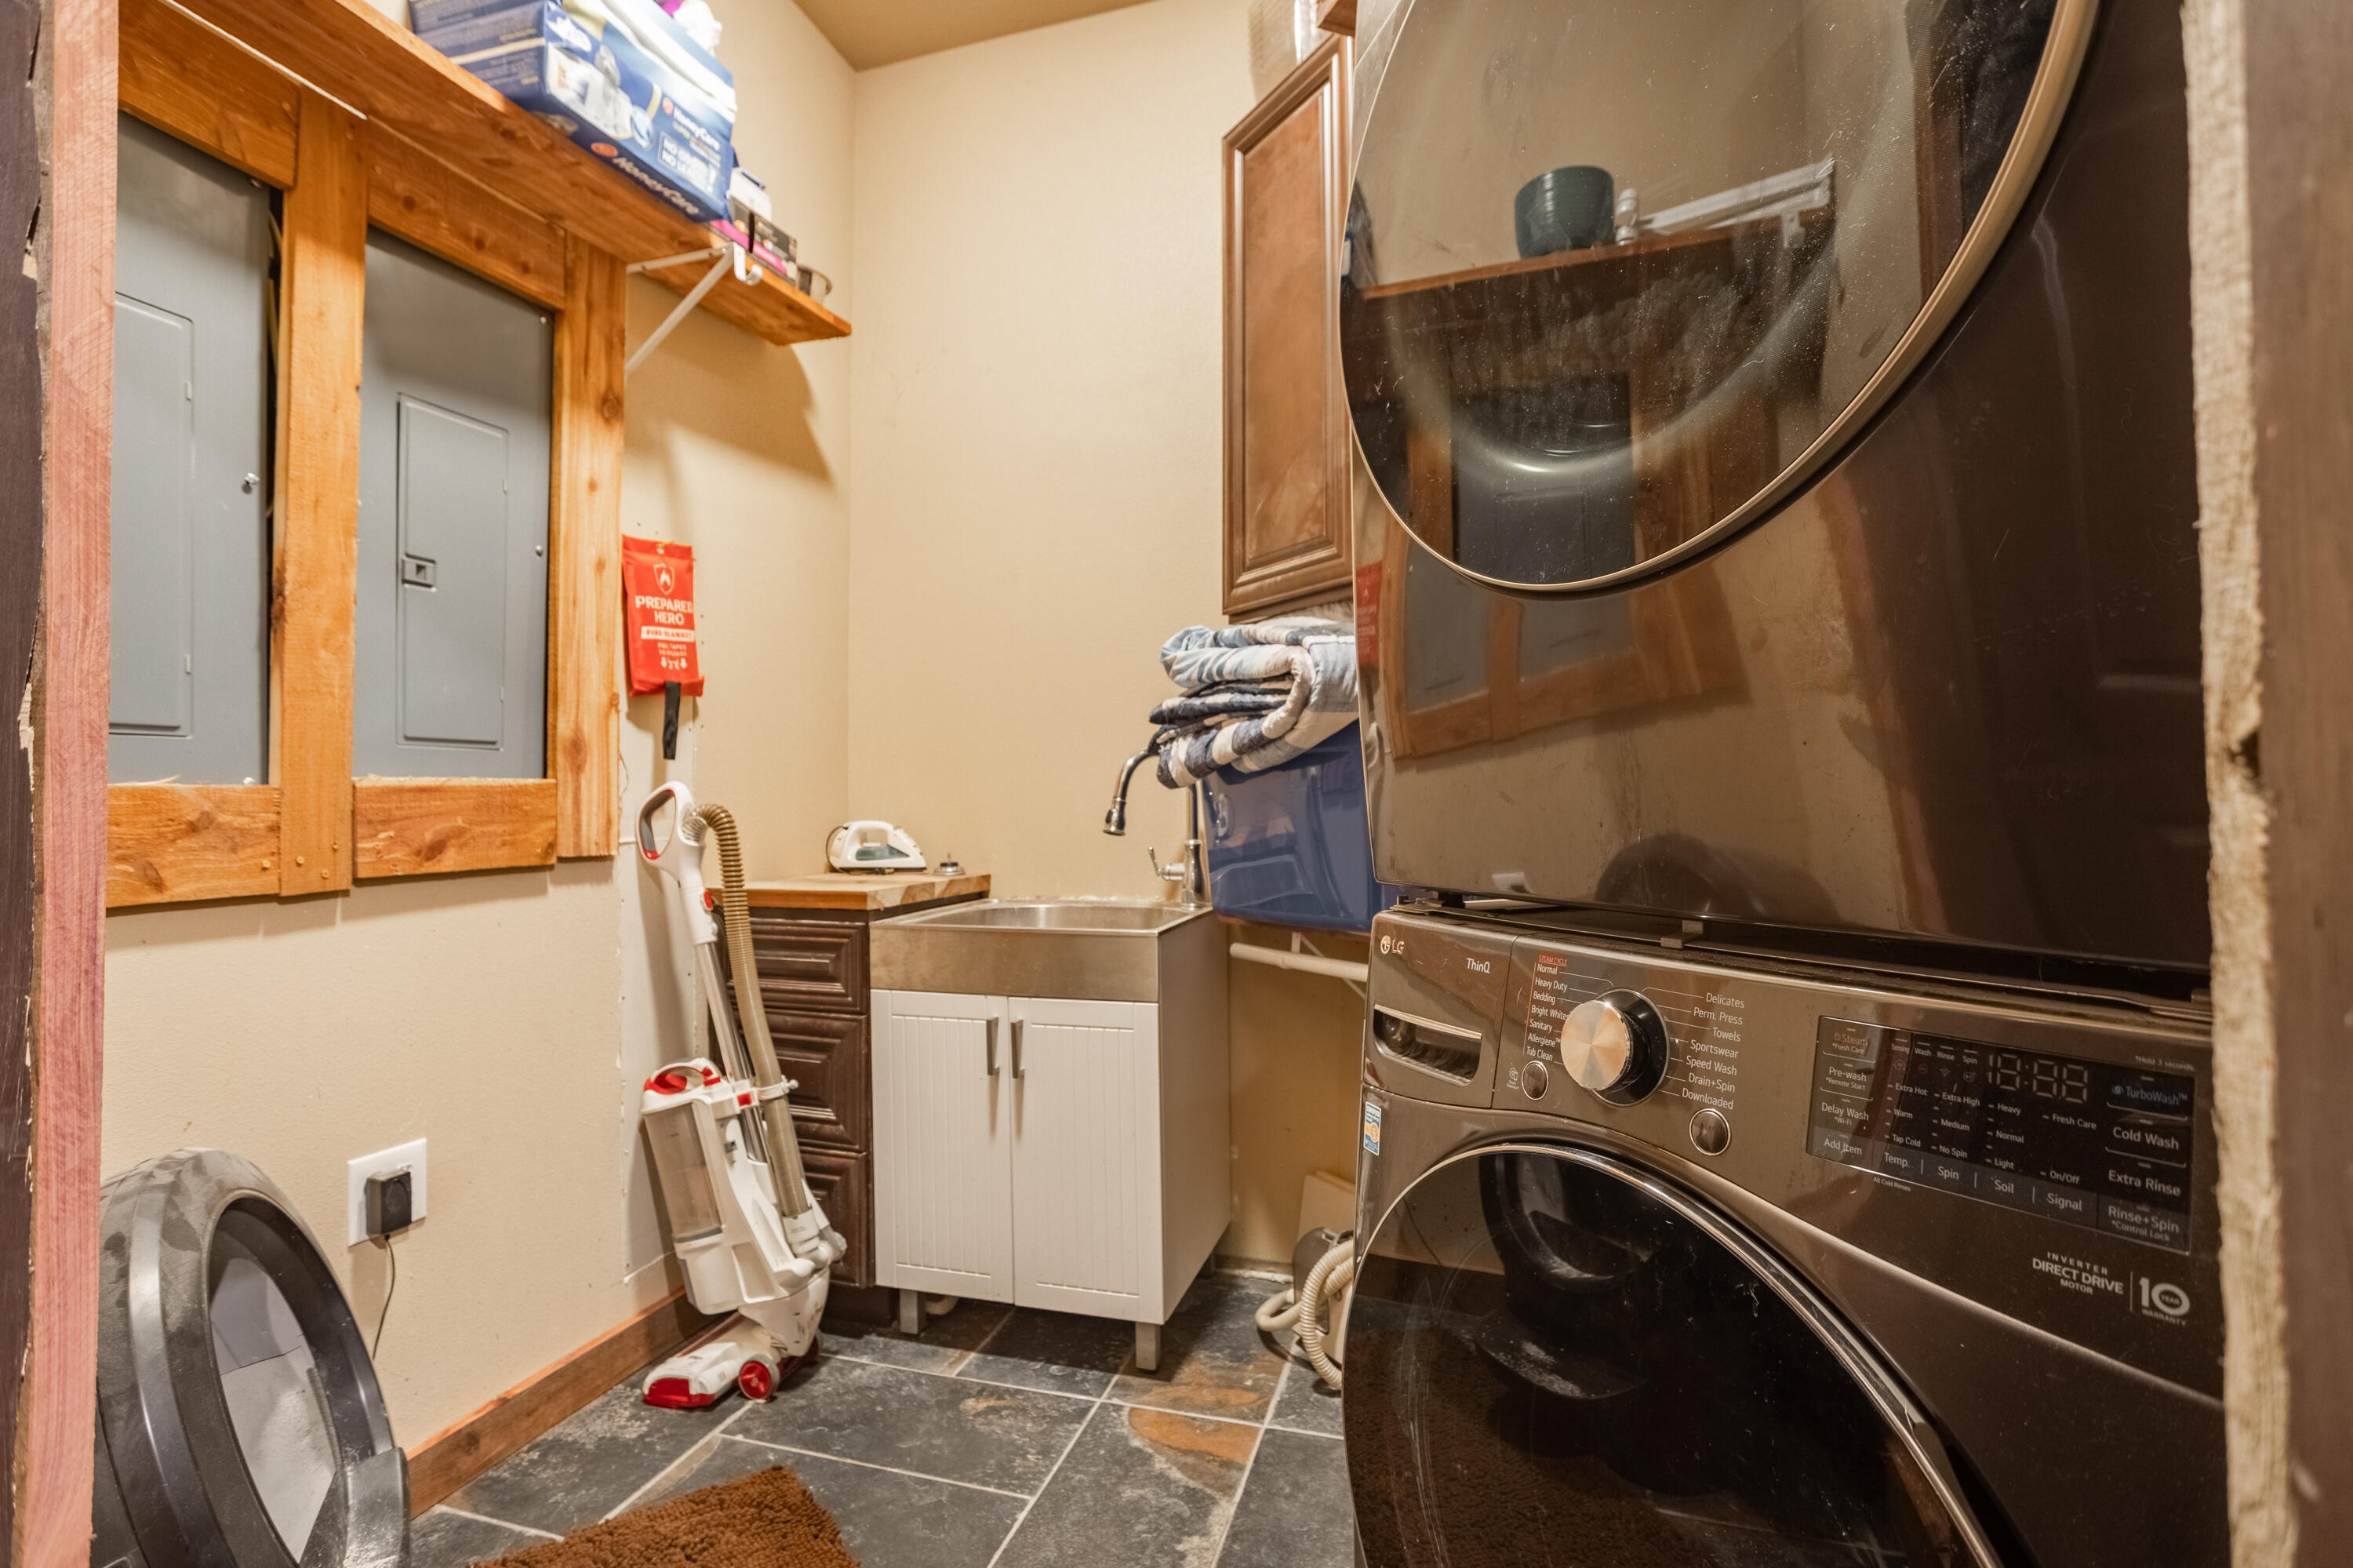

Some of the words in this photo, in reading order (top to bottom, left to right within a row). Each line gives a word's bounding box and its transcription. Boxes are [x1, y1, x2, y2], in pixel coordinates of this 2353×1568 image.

[654, 611, 684, 625] HERO
[1467, 958, 1490, 973] ThinQ
[1539, 955, 1554, 964] STEAM
[1537, 964, 1558, 974] Normal
[1535, 977, 1551, 990] Heavy
[1554, 980, 1568, 992] Duty
[1533, 991, 1555, 1005] Bedding
[1706, 992, 1744, 1009] Delicates
[1532, 1005, 1548, 1017] Bright
[1693, 1007, 1716, 1020] Perm.
[1719, 1012, 1743, 1025] Press
[1529, 1019, 1552, 1032] Sanitary
[1713, 1028, 1741, 1042] Towels
[1842, 1034, 1868, 1046] Steam
[1526, 1046, 1536, 1057] Tub
[1537, 1050, 1552, 1060] Clean
[1690, 1039, 1739, 1058] Sportswear
[1851, 1046, 1864, 1054] Care
[1891, 1043, 1909, 1054] Sensing
[1915, 1048, 1931, 1057] Wash
[1937, 1051, 1955, 1060] Rinse
[1686, 1055, 1711, 1070] Speed
[1715, 1062, 1737, 1076] Wash
[1962, 1056, 1977, 1064] Spin
[1829, 1067, 1867, 1082] Pre-wash
[1689, 1073, 1735, 1093] Drain+Spin
[1851, 1082, 1865, 1090] Start
[1896, 1082, 1913, 1093] Extra
[1915, 1086, 1928, 1096] Hot
[1682, 1088, 1734, 1110] Downloaded
[1943, 1092, 1961, 1102] Extra
[1962, 1096, 1980, 1107] High
[1822, 1102, 1844, 1115] Delay
[1846, 1108, 1869, 1121] Wash
[1894, 1108, 1913, 1118] Warm
[1997, 1104, 2021, 1116] Heavy
[1941, 1119, 1970, 1131] Medium
[2052, 1114, 2075, 1126] Fresh
[2078, 1118, 2097, 1130] Care
[1893, 1133, 1904, 1144] Tap
[1905, 1137, 1921, 1148] Cold
[1996, 1130, 2024, 1144] Normal
[2113, 1126, 2141, 1142] Cold
[2145, 1132, 2179, 1151] Wash
[1824, 1138, 1840, 1149] Add
[1843, 1143, 1862, 1155] Item
[1939, 1145, 1950, 1154] No
[1951, 1148, 1968, 1159] Spin
[1885, 1152, 1910, 1168] Temp.
[1995, 1159, 2015, 1170] Light
[1938, 1166, 1959, 1180] Spin
[2049, 1170, 2080, 1184] On/Off
[1893, 1182, 1911, 1191] Rinses
[1995, 1180, 2014, 1194] Soil
[2108, 1170, 2141, 1188] Extra
[2145, 1177, 2180, 1196] Rinse
[2046, 1193, 2082, 1211] Signal
[2108, 1206, 2179, 1234] Rinse+Spin
[2150, 1230, 2169, 1242] Lock
[2047, 1251, 2108, 1275] INVERTER
[2032, 1257, 2079, 1281] DIRECT
[2082, 1272, 2124, 1295] DRIVE
[2060, 1279, 2093, 1294] MOTOR
[2139, 1277, 2191, 1316] 10
[2160, 1293, 2180, 1305] YEAR
[2141, 1308, 2187, 1327] WARRANTY
